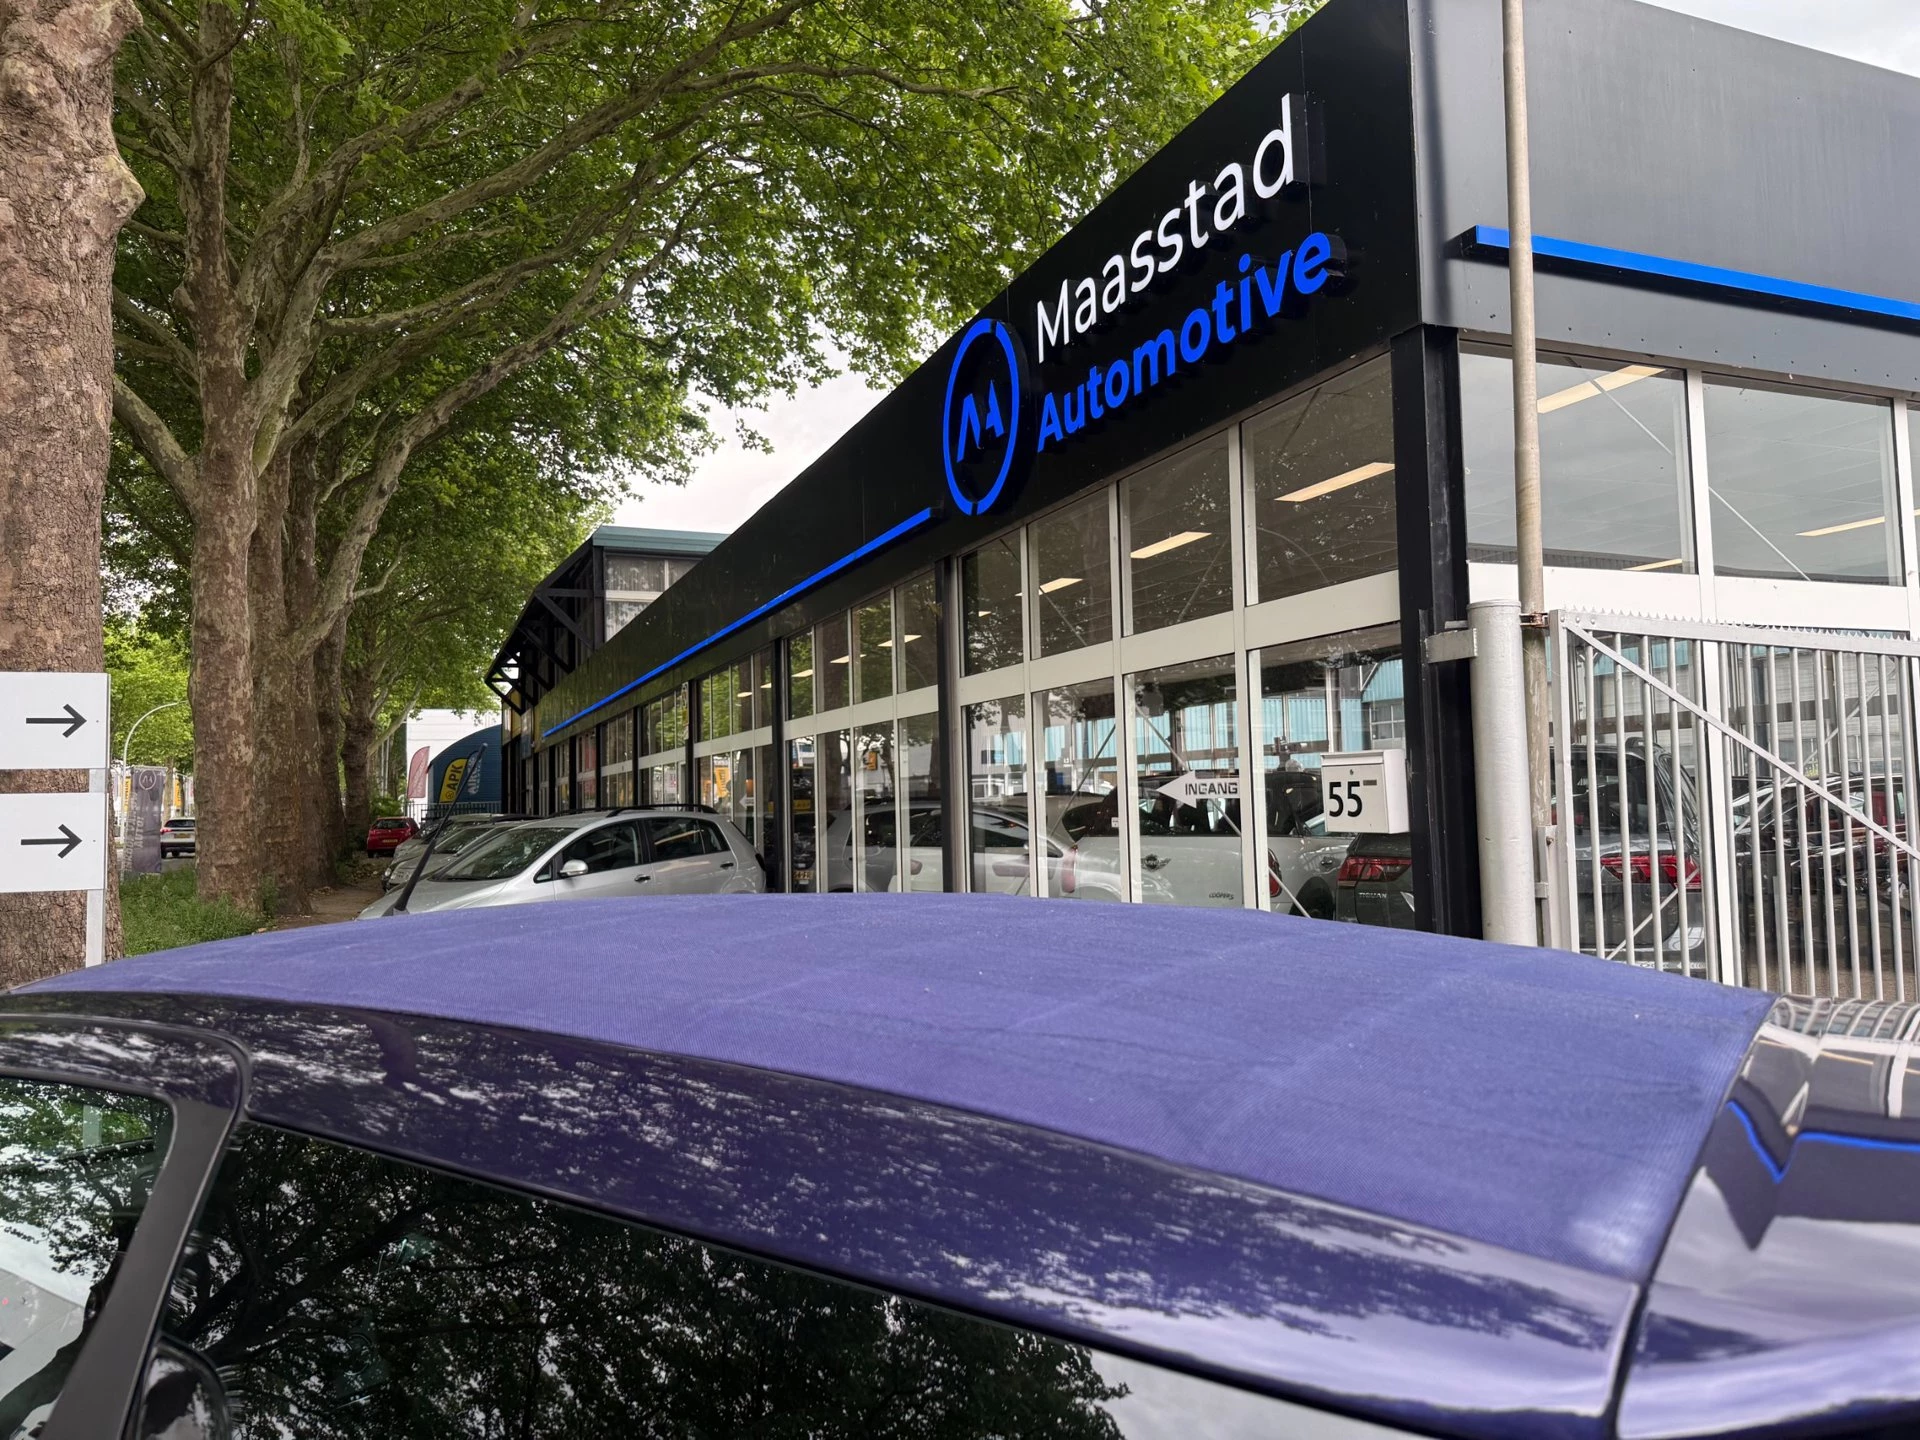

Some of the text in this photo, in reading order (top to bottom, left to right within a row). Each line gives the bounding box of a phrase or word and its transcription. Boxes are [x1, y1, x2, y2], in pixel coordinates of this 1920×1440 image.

[1036, 93, 1294, 364] Maasstad
[1037, 232, 1332, 453] Automotive
[446, 764, 463, 790] APK
[1184, 782, 1239, 796] INGANG
[1329, 780, 1363, 818] 55
